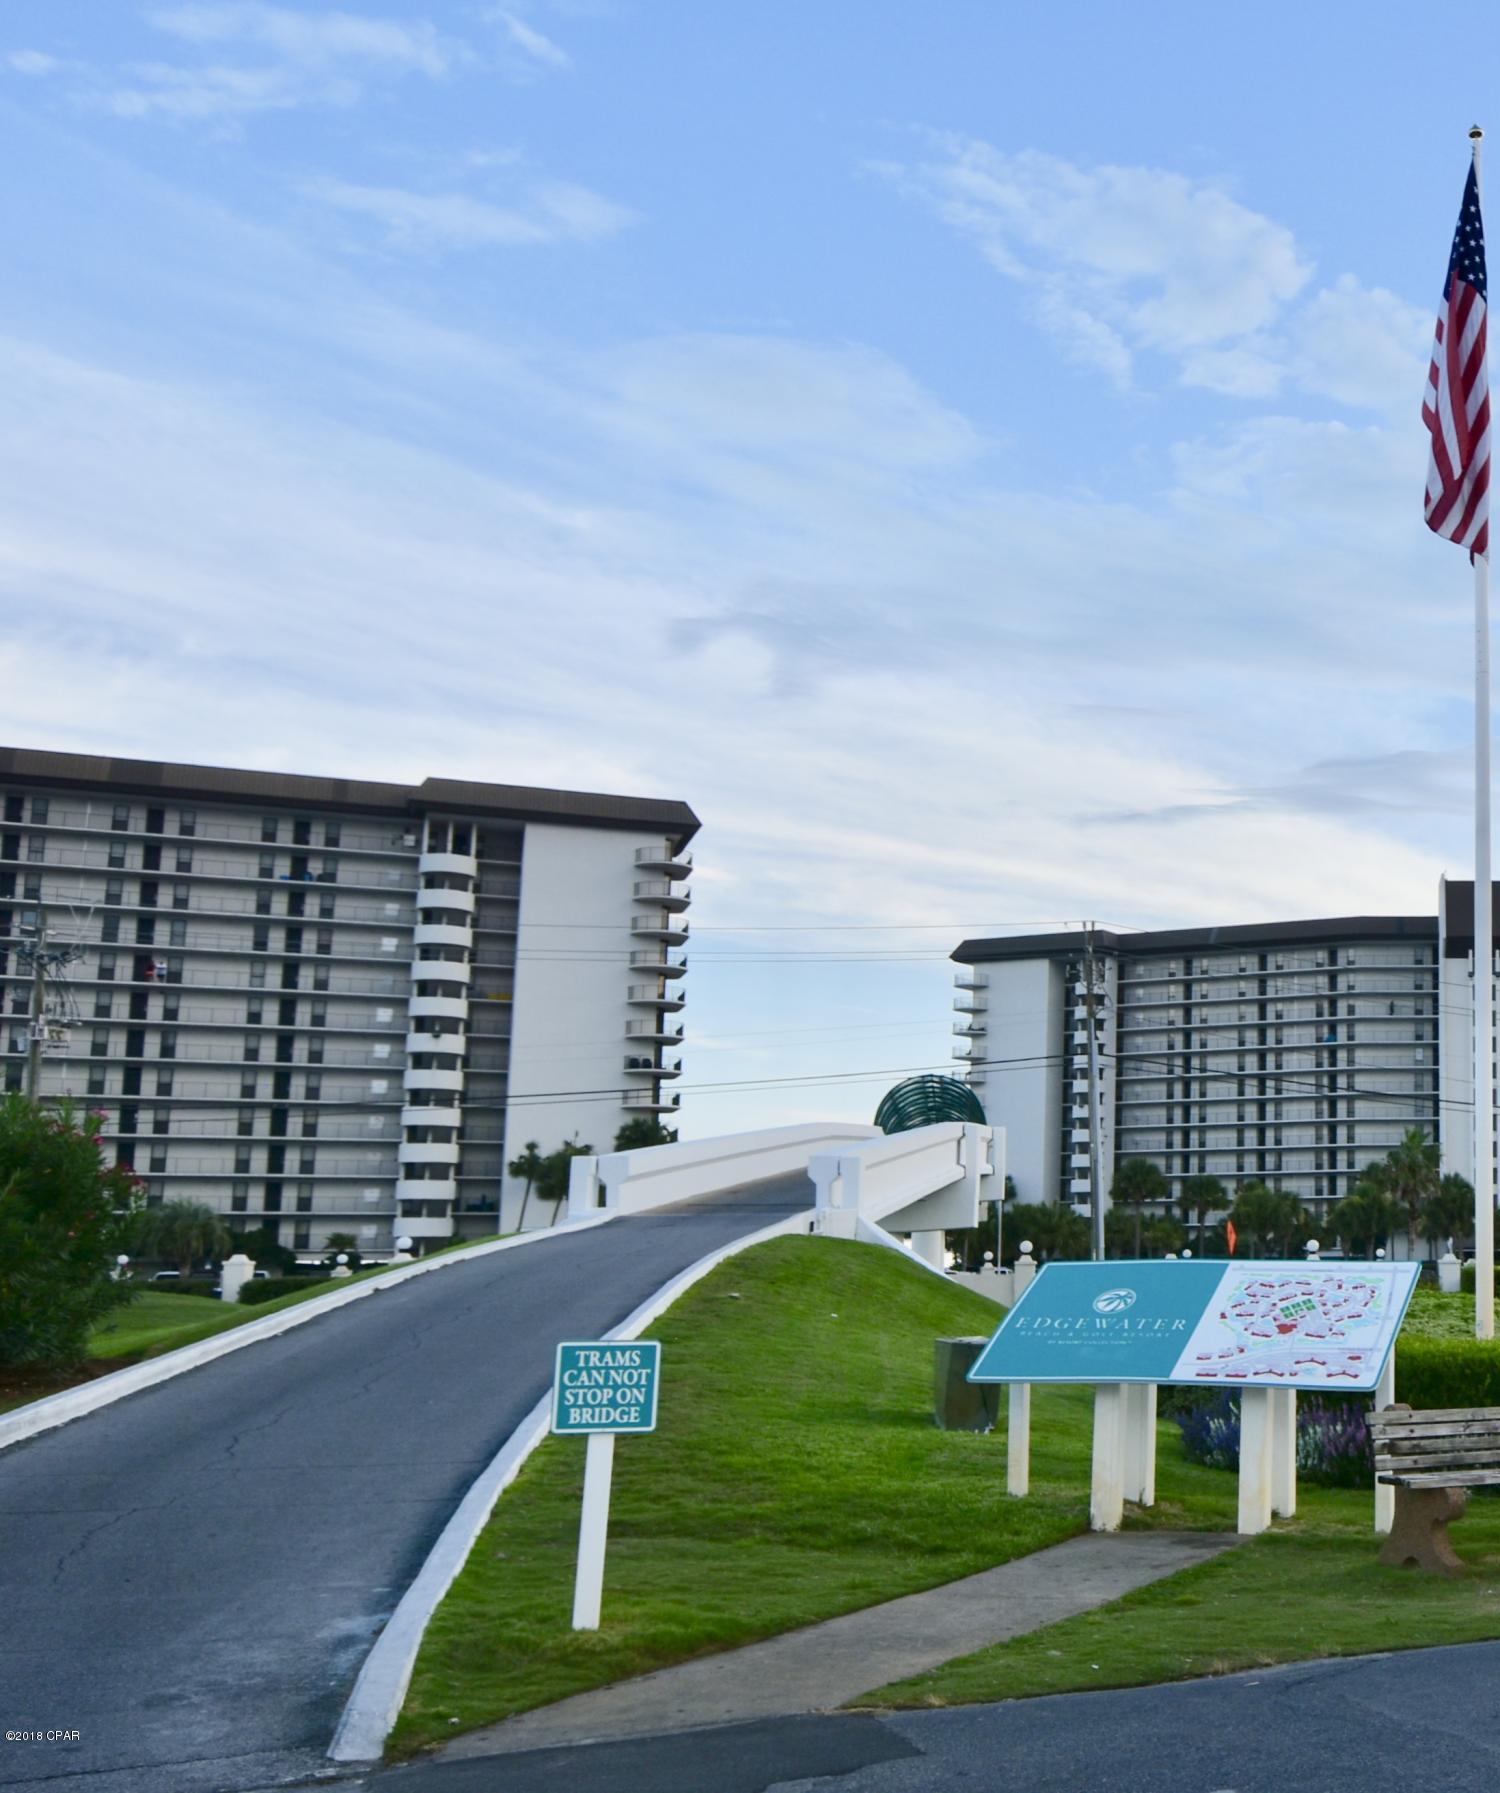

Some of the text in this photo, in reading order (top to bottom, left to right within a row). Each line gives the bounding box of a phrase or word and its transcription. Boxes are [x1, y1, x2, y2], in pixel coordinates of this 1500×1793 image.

[1015, 1317, 1187, 1331] EDGEWATER
[576, 1350, 641, 1367] TRAMS
[563, 1369, 651, 1386] CAN NOT
[564, 1388, 647, 1405] STOP ON
[568, 1407, 641, 1424] BRIDGE
